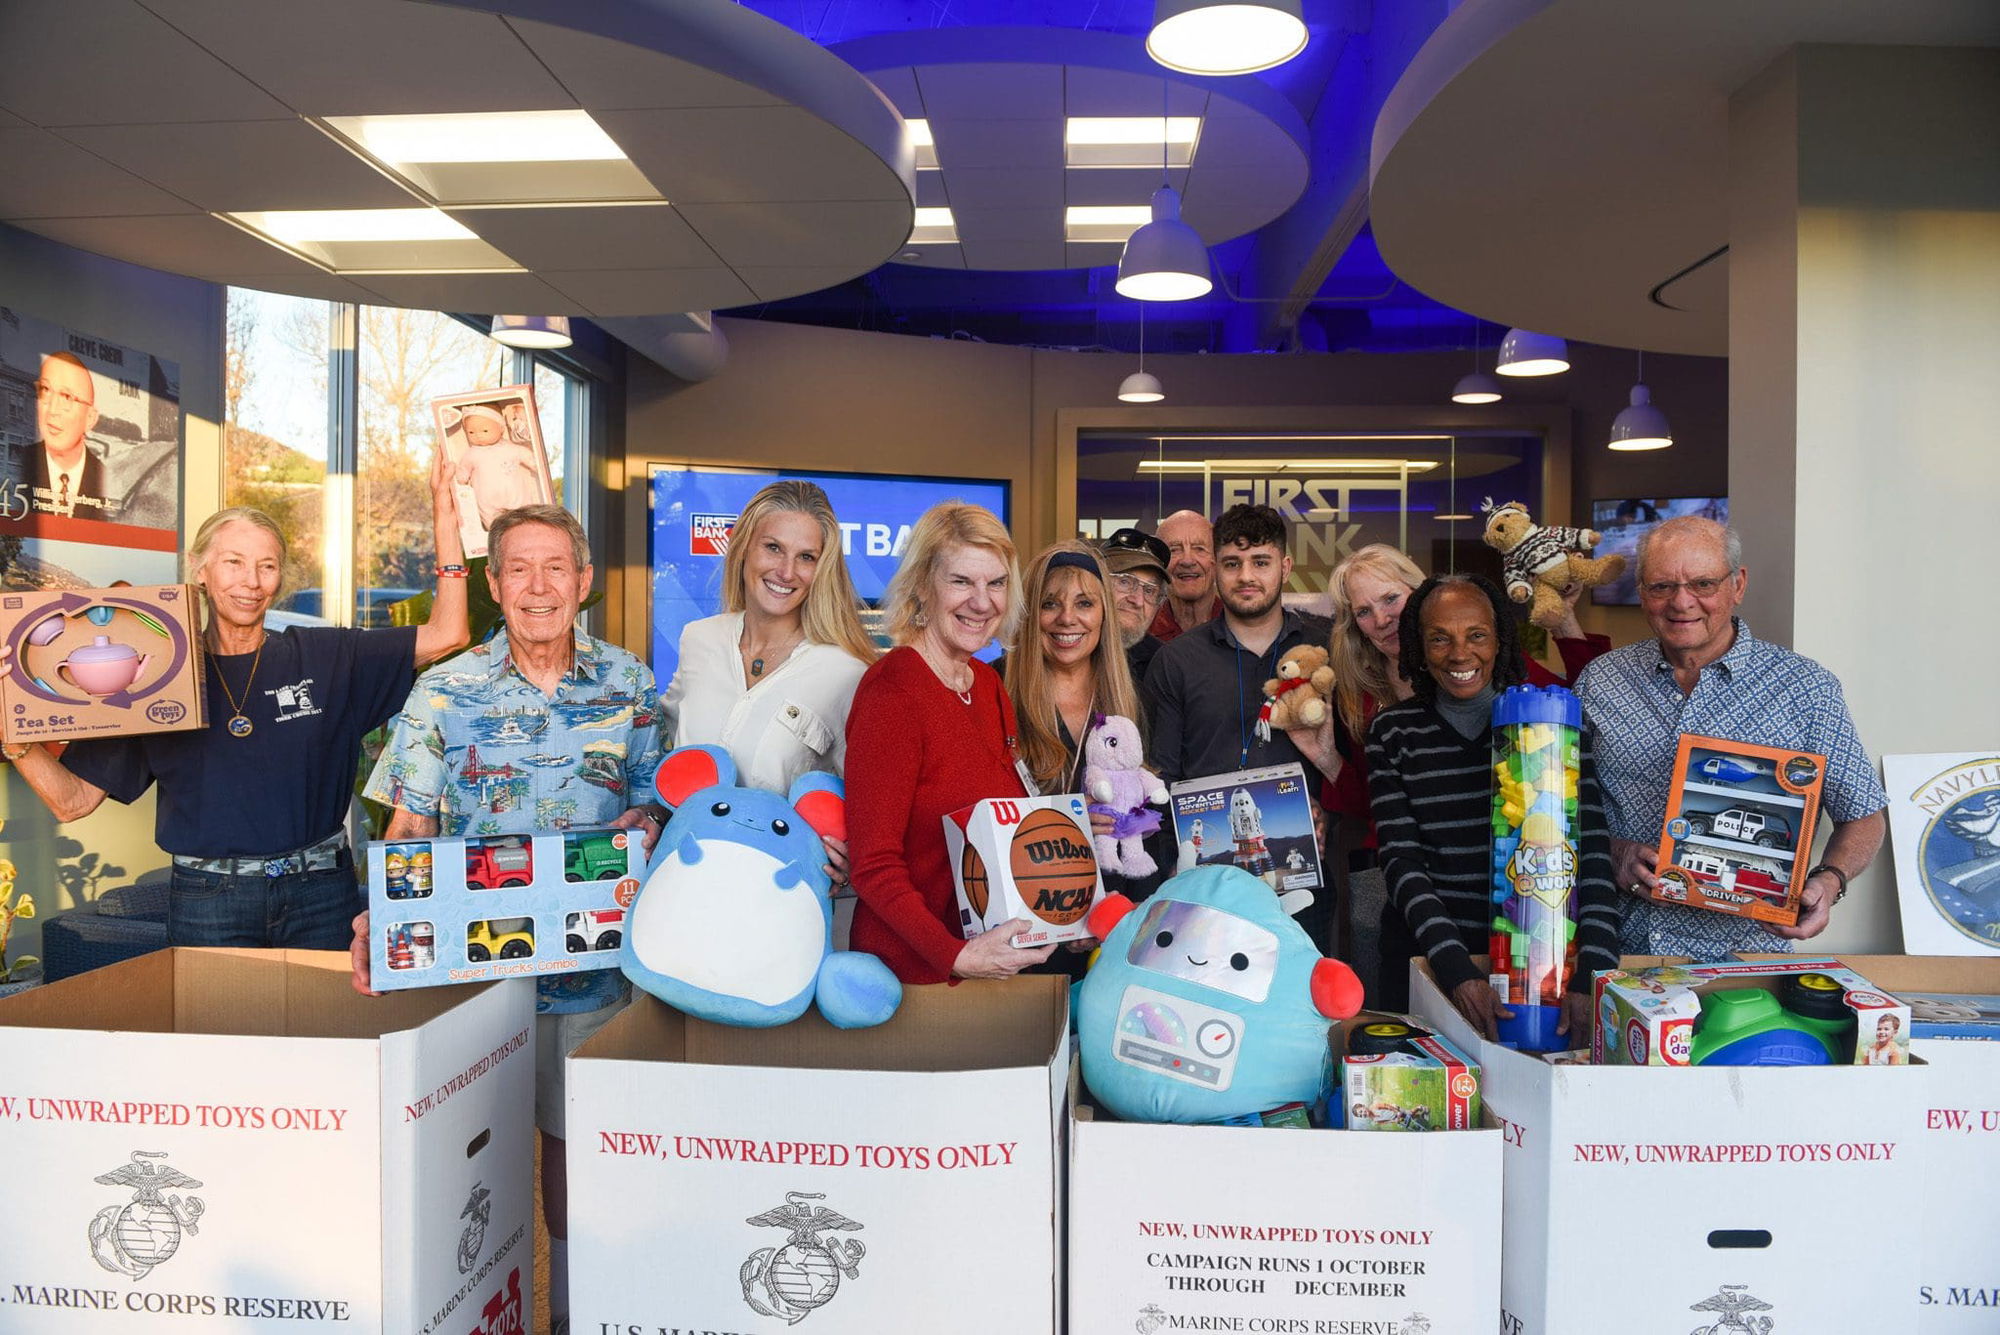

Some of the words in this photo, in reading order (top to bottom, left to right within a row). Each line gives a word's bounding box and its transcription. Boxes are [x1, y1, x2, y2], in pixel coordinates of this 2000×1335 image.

[694, 516, 737, 528] FIRST
[694, 527, 730, 542] BANK
[151, 704, 179, 717] green
[160, 711, 180, 720] toys
[15, 718, 44, 729] Tea
[49, 715, 75, 726] Set
[1177, 791, 1225, 806] SPACE
[1179, 799, 1225, 811] ADVENTURE
[1717, 819, 1756, 835] POLICE
[1514, 845, 1575, 875] Kids
[623, 881, 635, 894] 11
[1706, 889, 1745, 904] DRIVEN
[449, 967, 487, 981] Super
[491, 963, 534, 976] Trucks
[537, 958, 578, 971] Combo
[404, 1093, 435, 1122] NEW,
[436, 1057, 490, 1104] UNWRAPPED
[490, 1042, 511, 1067] TOYS
[509, 1027, 530, 1053] ONLY
[28, 1098, 190, 1126] UNWRAPPED
[196, 1105, 265, 1129] TOYS
[271, 1108, 348, 1131] ONLY
[1499, 1116, 1527, 1149] LY
[600, 1131, 668, 1161] NEW,
[674, 1136, 849, 1167] UNWRAPPED
[856, 1145, 930, 1171] TOYS
[936, 1142, 1018, 1170] ONLY
[1573, 1144, 1629, 1165] NEW,
[1635, 1145, 1772, 1164] UNWRAPPED
[1776, 1144, 1831, 1163] TOYS
[1836, 1143, 1896, 1162] ONLY
[1138, 1222, 1187, 1239] NEW,
[1193, 1224, 1318, 1243] UNWRAPPED
[1323, 1229, 1375, 1245] TOYS
[1380, 1230, 1434, 1245] ONLY
[1147, 1253, 1252, 1271] CAMPAIGN
[1258, 1257, 1310, 1273] RUNS
[1316, 1258, 1323, 1273] 1
[1329, 1259, 1426, 1276] OCTOBER
[432, 1285, 467, 1330] MARINE
[467, 1256, 494, 1293] CORPS
[493, 1223, 525, 1266] RESERVE
[1165, 1275, 1265, 1294] THROUGH
[1295, 1280, 1406, 1297] DECEMBER
[12, 1284, 120, 1310] MARINE
[125, 1291, 216, 1316] CORPS
[223, 1296, 350, 1321] RESERVE
[1168, 1315, 1244, 1331] MARINE
[1249, 1318, 1309, 1334] CORPS
[1315, 1321, 1398, 1335] RESERVE
